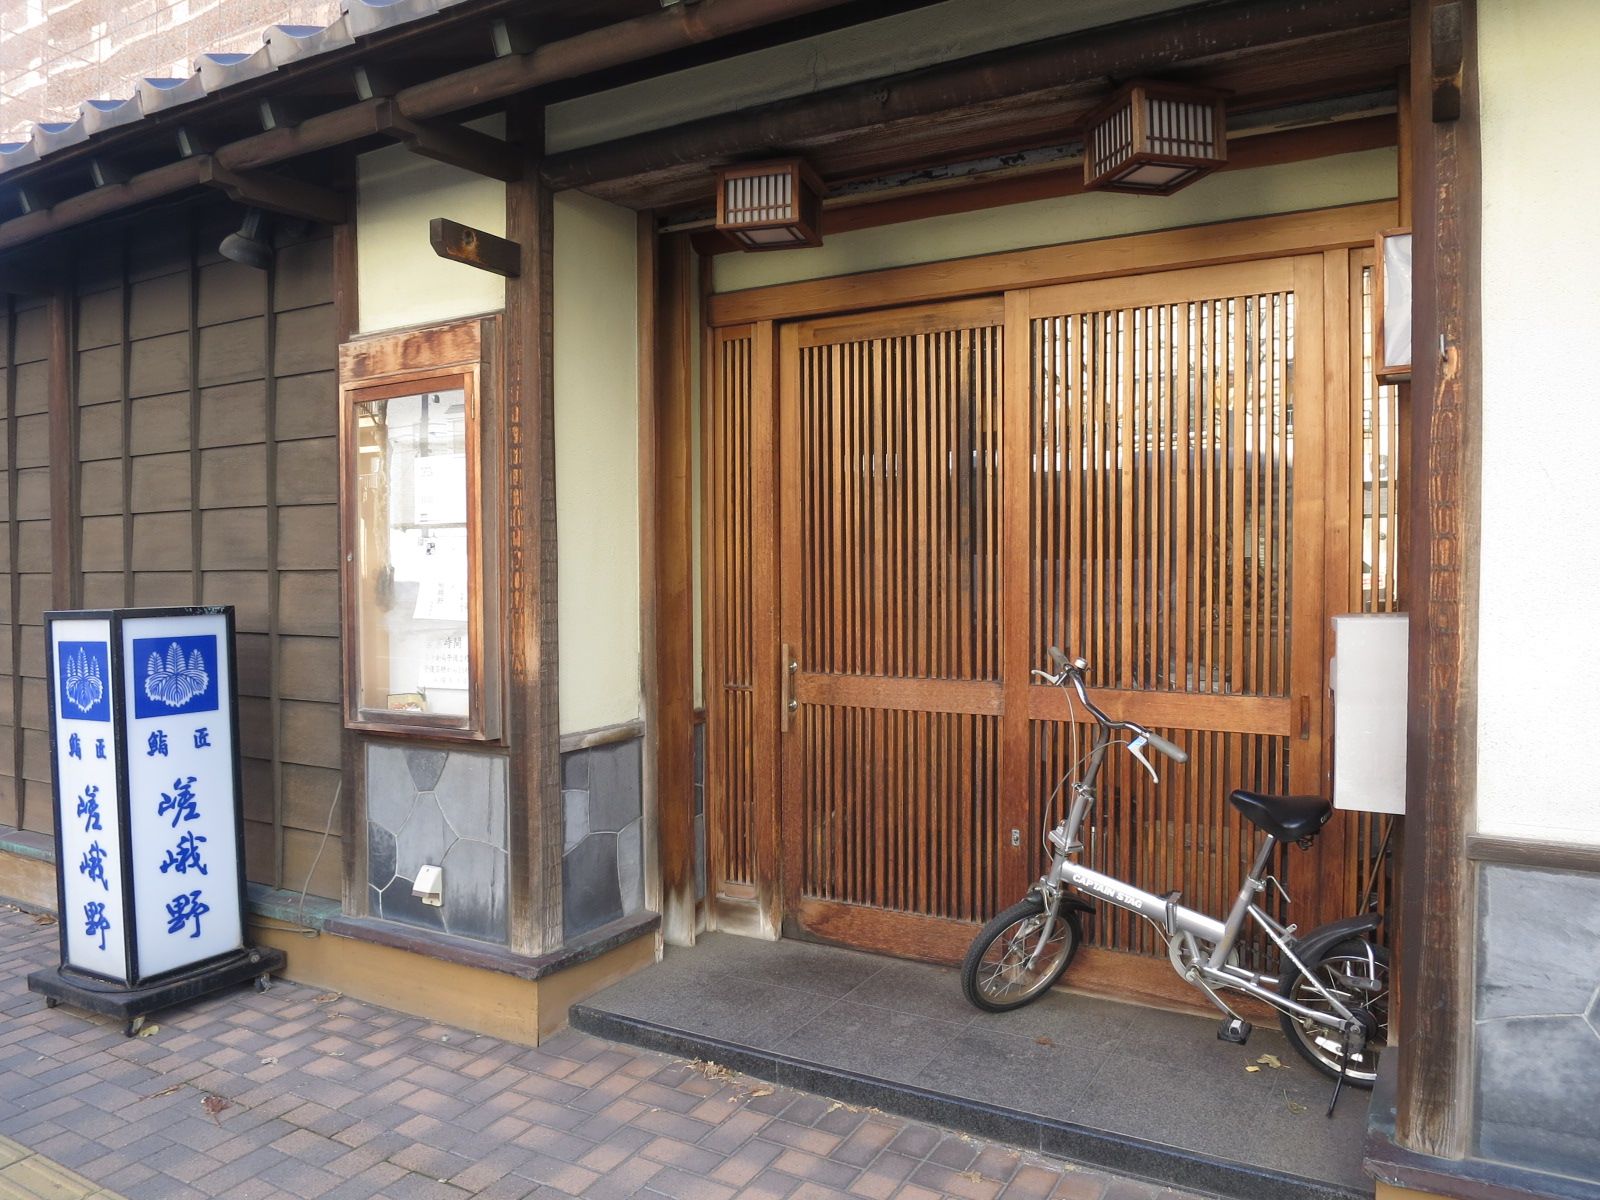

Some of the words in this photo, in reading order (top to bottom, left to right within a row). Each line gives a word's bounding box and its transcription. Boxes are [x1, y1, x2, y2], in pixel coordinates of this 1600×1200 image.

[77, 785, 111, 950] 嵯峨野
[157, 776, 211, 939] 嵯峨野
[1072, 873, 1115, 897] CAPTAIN
[1116, 891, 1143, 909] STAG
